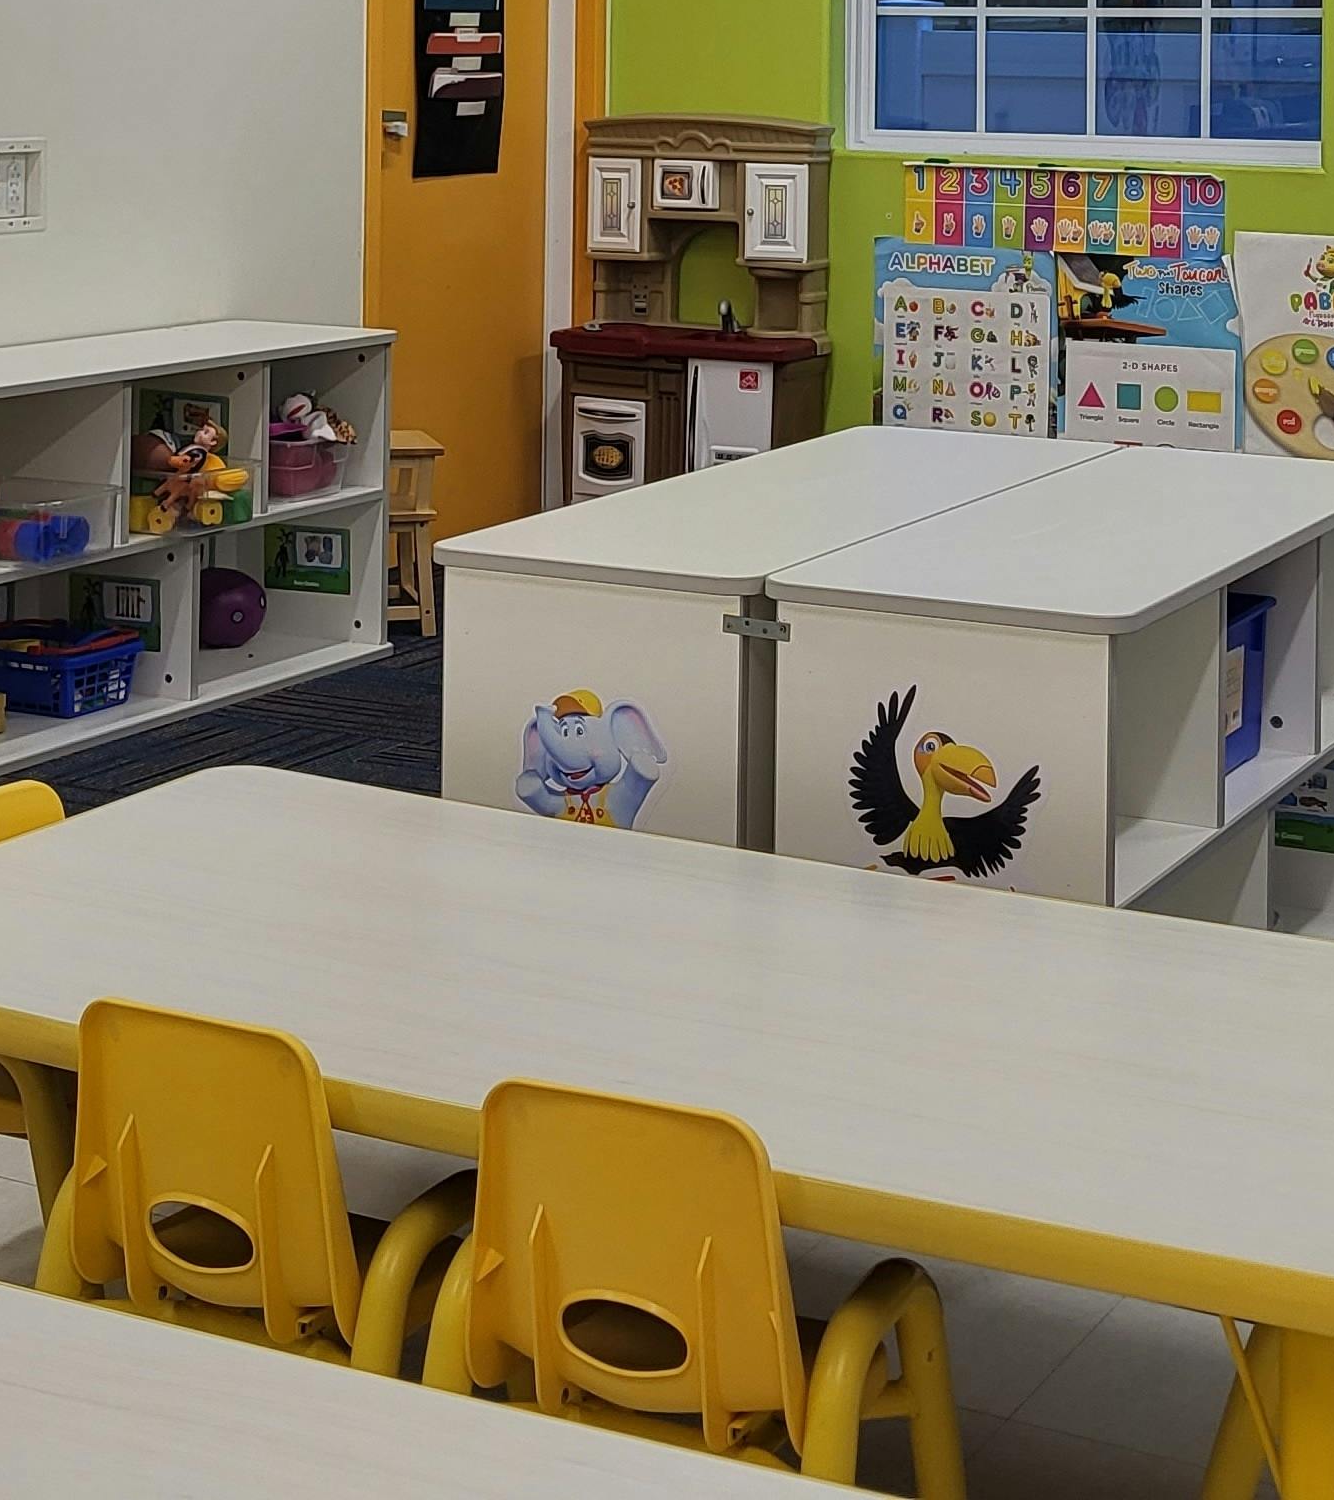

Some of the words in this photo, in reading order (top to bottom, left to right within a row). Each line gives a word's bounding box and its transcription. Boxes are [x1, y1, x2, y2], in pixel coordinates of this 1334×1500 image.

[913, 166, 926, 192] 1
[938, 168, 960, 194] 2
[968, 169, 990, 196] 3
[998, 171, 1021, 198] 4
[1029, 171, 1052, 198] 5
[1059, 172, 1083, 199] 6
[1093, 173, 1115, 200] 7
[1124, 174, 1145, 202] 8
[1154, 174, 1178, 204] 9
[1184, 176, 1223, 206] 10
[888, 252, 995, 276] ALPHABET
[1123, 260, 1156, 279] Two
[1158, 281, 1203, 297] Shapes
[894, 295, 908, 312] A
[933, 298, 945, 315] B
[971, 301, 984, 316] C
[1010, 303, 1023, 319] D
[895, 323, 906, 338] E
[934, 326, 944, 341] F
[970, 328, 985, 343] G
[1010, 330, 1023, 346] H
[896, 349, 905, 366] I
[933, 352, 944, 367] J
[971, 354, 983, 371] K
[1011, 357, 1022, 373] L
[1122, 362, 1138, 370] 2-D
[1141, 363, 1178, 372] SHAPES
[893, 376, 907, 392] M
[933, 379, 944, 395] N
[969, 381, 984, 397] O
[1010, 385, 1022, 401] P
[892, 404, 907, 420] Q
[933, 407, 943, 423] R
[970, 411, 982, 427] S
[1008, 414, 1022, 430] T
[1079, 413, 1104, 422] Triangle
[1188, 421, 1220, 430] Rectangle
